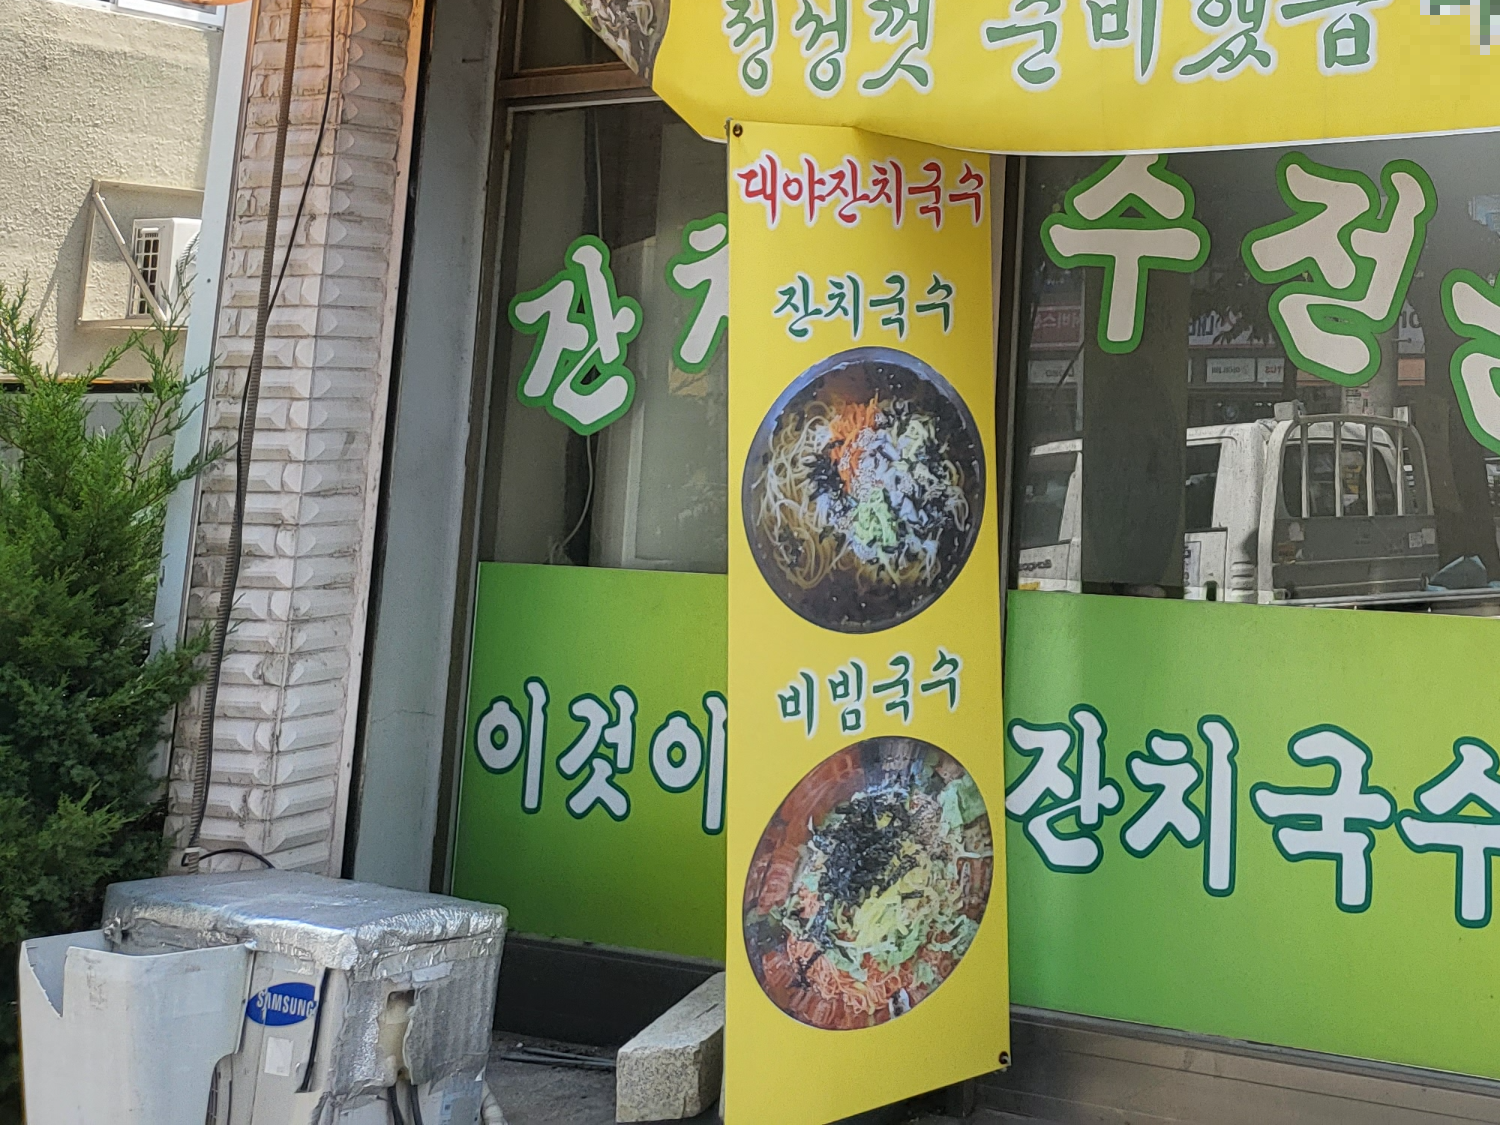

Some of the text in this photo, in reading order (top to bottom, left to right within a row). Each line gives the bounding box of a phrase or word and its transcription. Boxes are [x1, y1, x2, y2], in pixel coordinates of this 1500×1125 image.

[735, 152, 987, 229] 대야잔치국수
[773, 271, 957, 339] 잔치국수
[776, 647, 963, 737] 비빔국수
[474, 676, 727, 835] 이것이
[256, 990, 317, 1017] SAMSUNG
